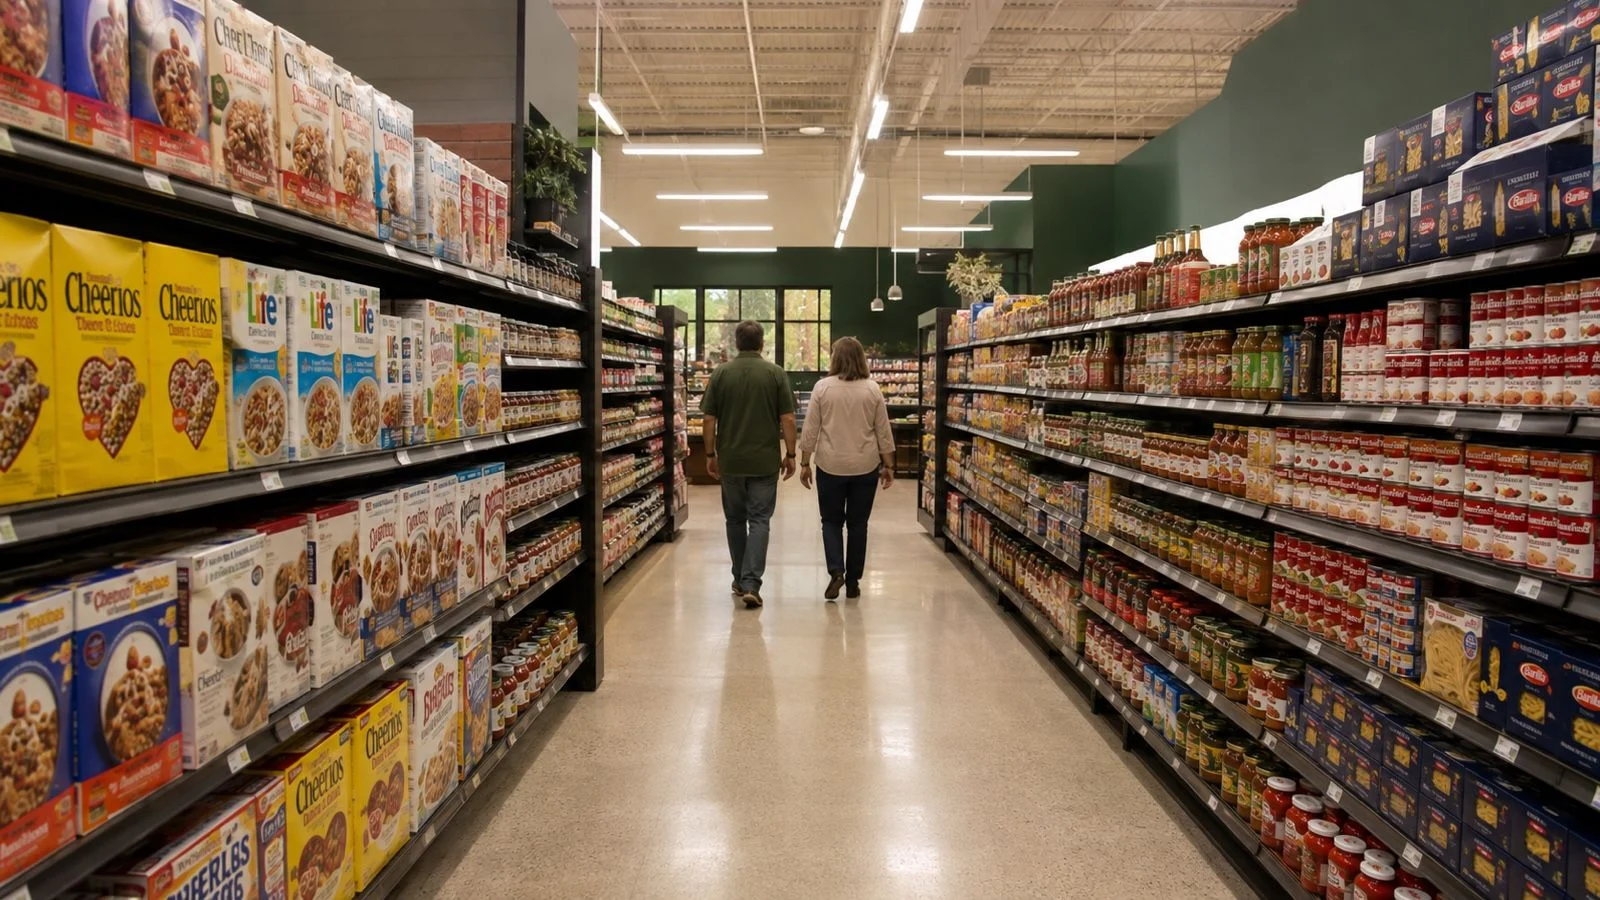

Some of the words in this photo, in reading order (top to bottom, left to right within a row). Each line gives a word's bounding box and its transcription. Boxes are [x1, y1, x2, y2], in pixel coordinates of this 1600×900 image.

[65, 272, 142, 318] Cheerios
[159, 283, 218, 325] Cheerios
[247, 281, 278, 326] Life
[310, 290, 334, 331] Life
[353, 297, 375, 334] Life
[366, 710, 403, 760] Cheerios
[296, 756, 344, 815] Cheerios
